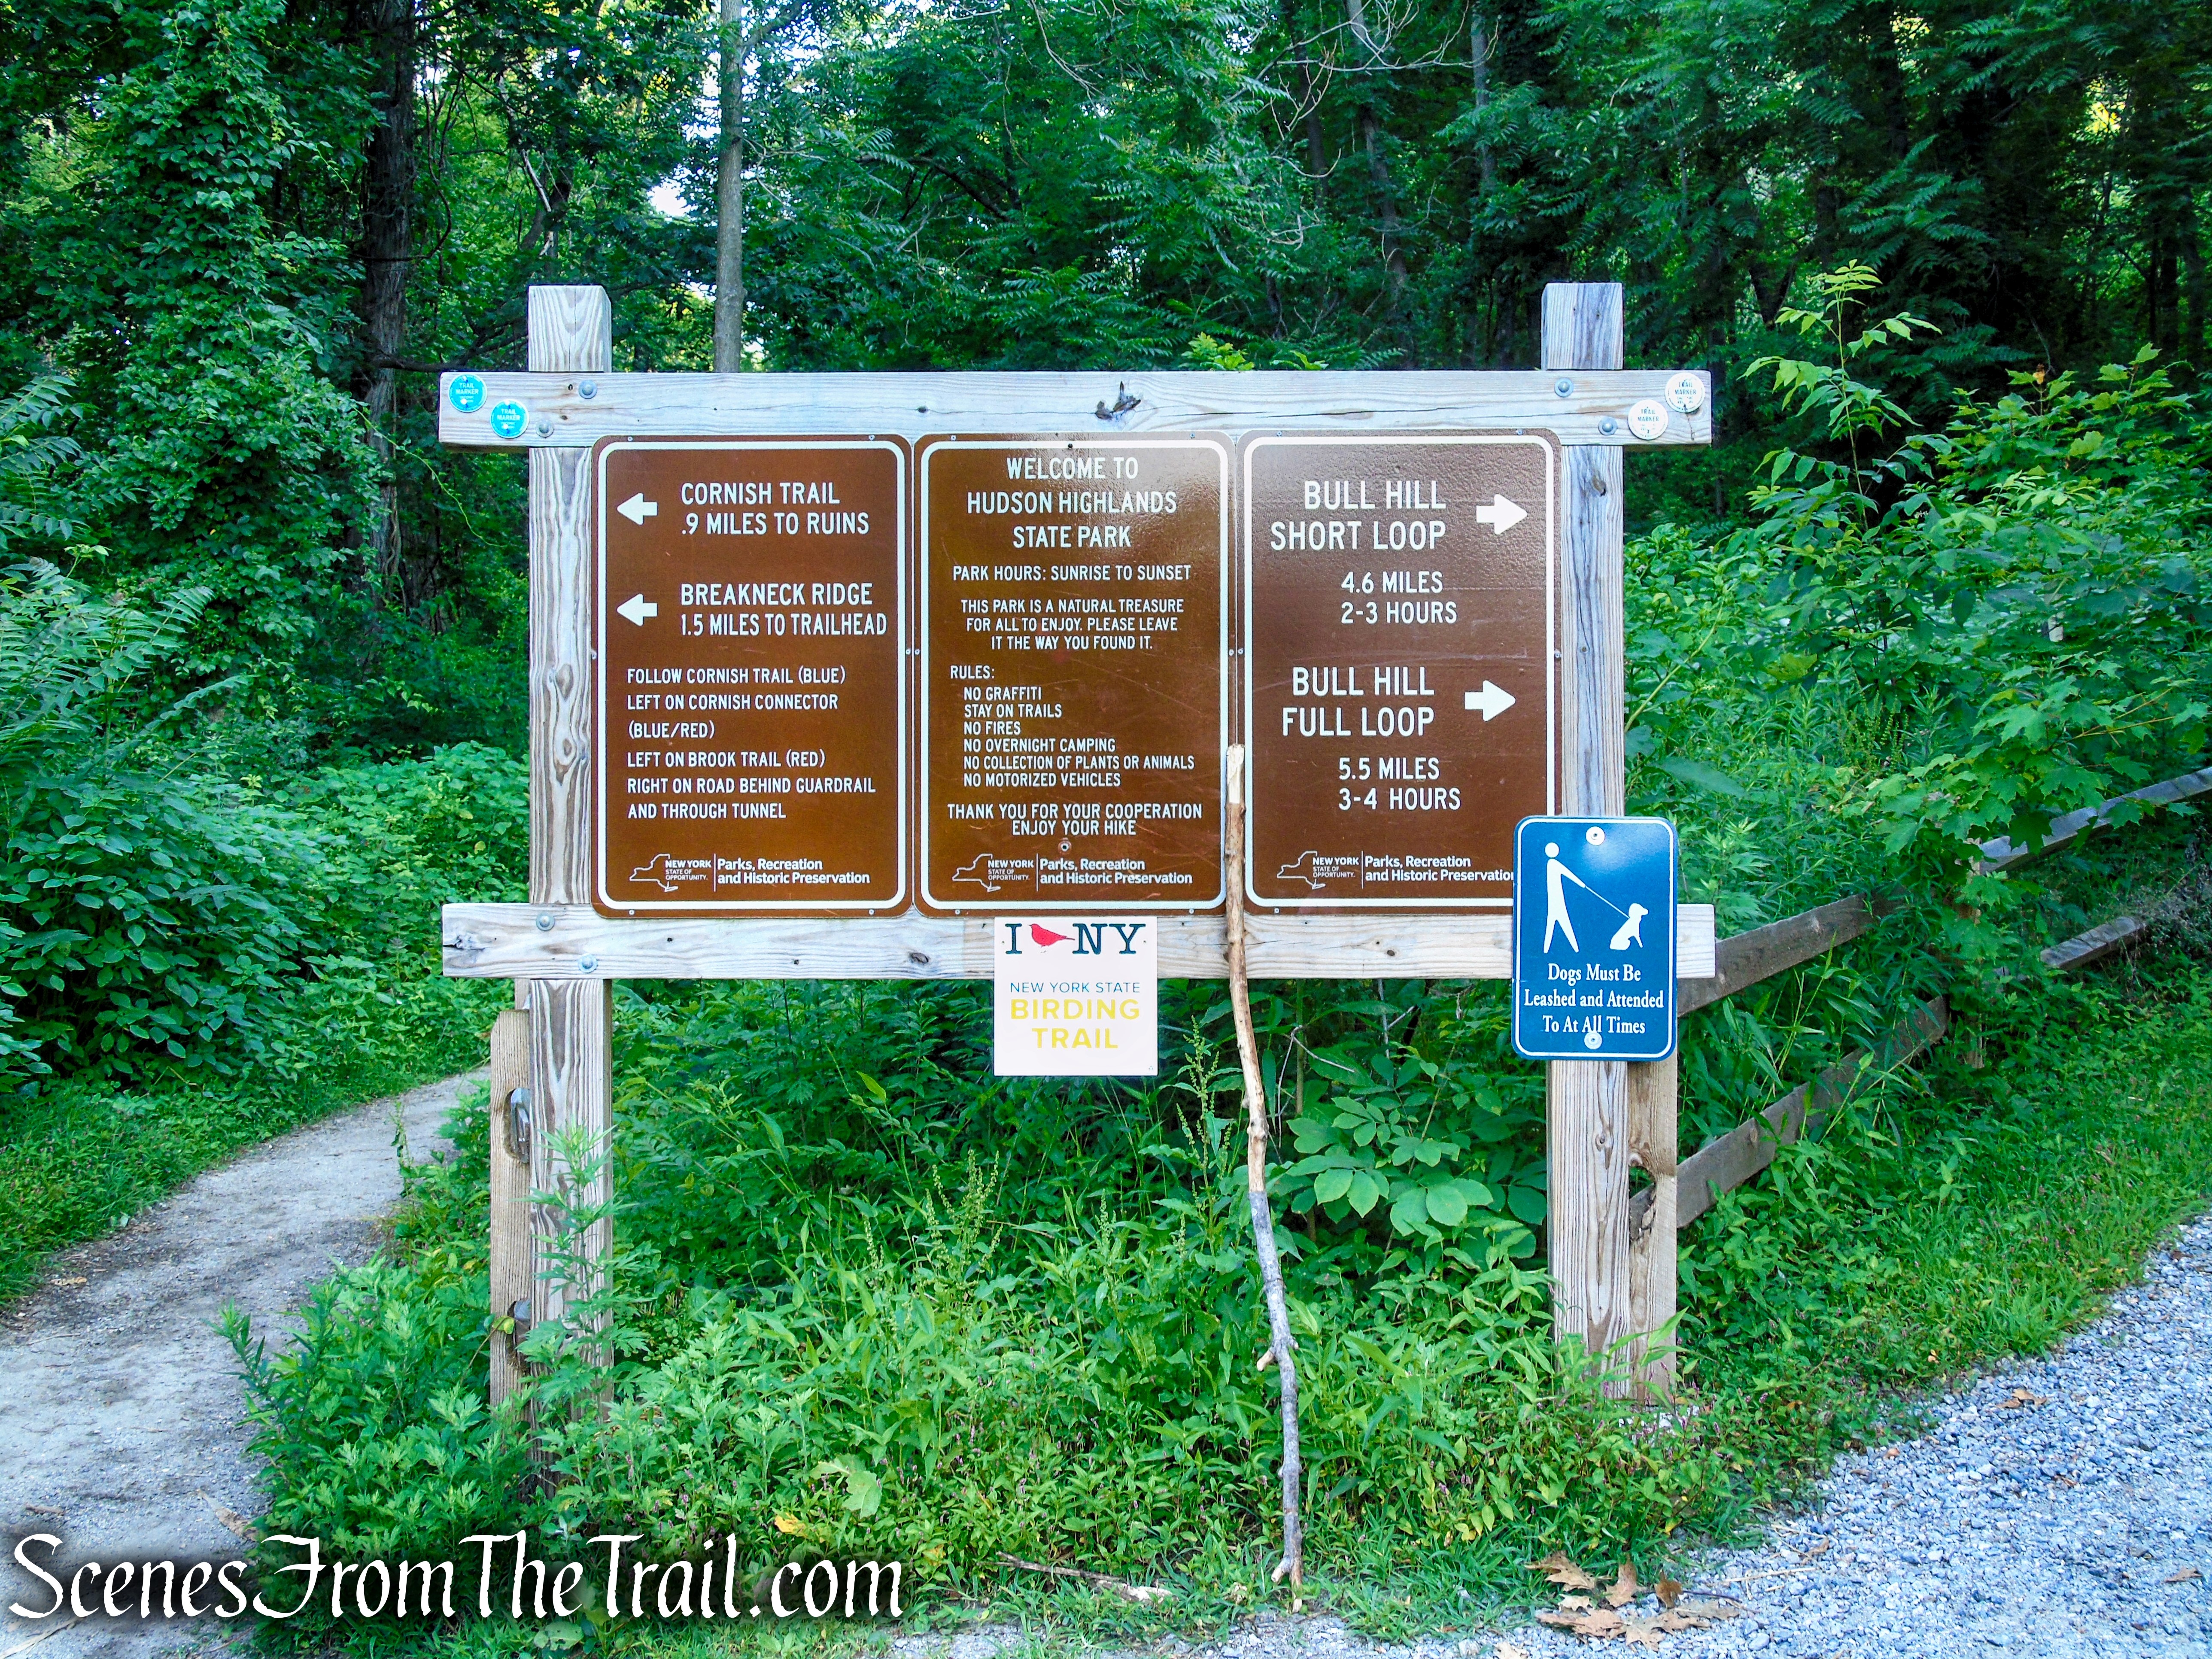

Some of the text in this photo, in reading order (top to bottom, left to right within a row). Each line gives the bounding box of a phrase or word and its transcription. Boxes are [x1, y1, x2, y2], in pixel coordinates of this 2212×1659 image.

[1006, 456, 1139, 480] WELCOME TO
[681, 482, 840, 505] CORNISH TRAIL
[1304, 480, 1446, 510] BULL HILL
[968, 491, 1177, 514] HUDSON HIGHLANDS
[682, 512, 869, 535] .9 MILES TO RUINS
[1013, 524, 1132, 548] STATE PARK
[1270, 519, 1446, 550] SHORT LOOP
[953, 565, 1191, 581] PARK HOURS: SUNRISE TO SUNSET
[1341, 571, 1443, 594] 4.6 MILES
[681, 583, 873, 606] BREAKNECK RIDGE
[961, 599, 1184, 614] THIS PARK IS A NATURAL TREASURE
[1341, 601, 1457, 624] 2-3 HOURS
[681, 613, 887, 636] 1.5 MILES TO TRAILHEAD
[966, 617, 1178, 632] FOR ALL TO ENJOY. PLEASE LEAVE
[991, 635, 1153, 650] IT THE WAY YOU FOUND IT.
[628, 665, 845, 684] FOLLOW CORNISH TRAIL (BLUE)
[950, 665, 994, 679] RULES:
[1293, 666, 1434, 696] BULL HILL
[628, 694, 838, 710] LEFT ON CORNISH CONNECTOR
[964, 686, 1041, 701] NO GRAFFITI
[964, 704, 1062, 718] STAY ON TRAILS
[629, 720, 715, 739] (BLUE/RED)
[964, 721, 1021, 735] NO FIRES
[1282, 707, 1434, 737] FULL LOOP
[964, 738, 1115, 753] NO OVERNIGHT CAMPING
[628, 748, 825, 768] LEFT ON BROOK TRAIL (RED)
[964, 755, 1194, 770] NO COLLECTION OF PLANTS OR ANIMALS
[1339, 757, 1440, 780] 5.5 MILES
[628, 777, 876, 794] RIGHT ON ROAD BEHIND GUARDRAIL
[964, 772, 1121, 787] NO MOTORIZED VEHICLES
[1339, 787, 1460, 810] 3-4 HOURS
[628, 803, 787, 819] AND THROUGH TUNNEL
[947, 803, 1202, 820] THANK YOU FOR YOUR COOPERATION
[1012, 820, 1136, 836] ENJOY YOUR HIKE
[665, 860, 712, 868] NEW YORK
[717, 857, 823, 872] Parks, Recreation
[988, 860, 1034, 868] NEW YORK
[1039, 857, 1145, 872] Parks, Recreation
[1313, 857, 1359, 865] NEW YORK
[1365, 854, 1471, 869] Parks, Recreation
[717, 871, 870, 884] and Historic Preservation
[1040, 871, 1193, 884] and Historic Preservation
[1365, 869, 1389, 881] and
[1391, 869, 1438, 881] Historic
[1005, 923, 1146, 955] I NY
[1548, 963, 1641, 987] Dogs Must Be
[1010, 982, 1140, 993] NEW YORK STATE
[1524, 988, 1664, 1008] Leashed and Attended
[1011, 999, 1139, 1020] BIRDING
[1542, 1015, 1645, 1034] To At All Times
[1032, 1028, 1118, 1048] TRAIL
